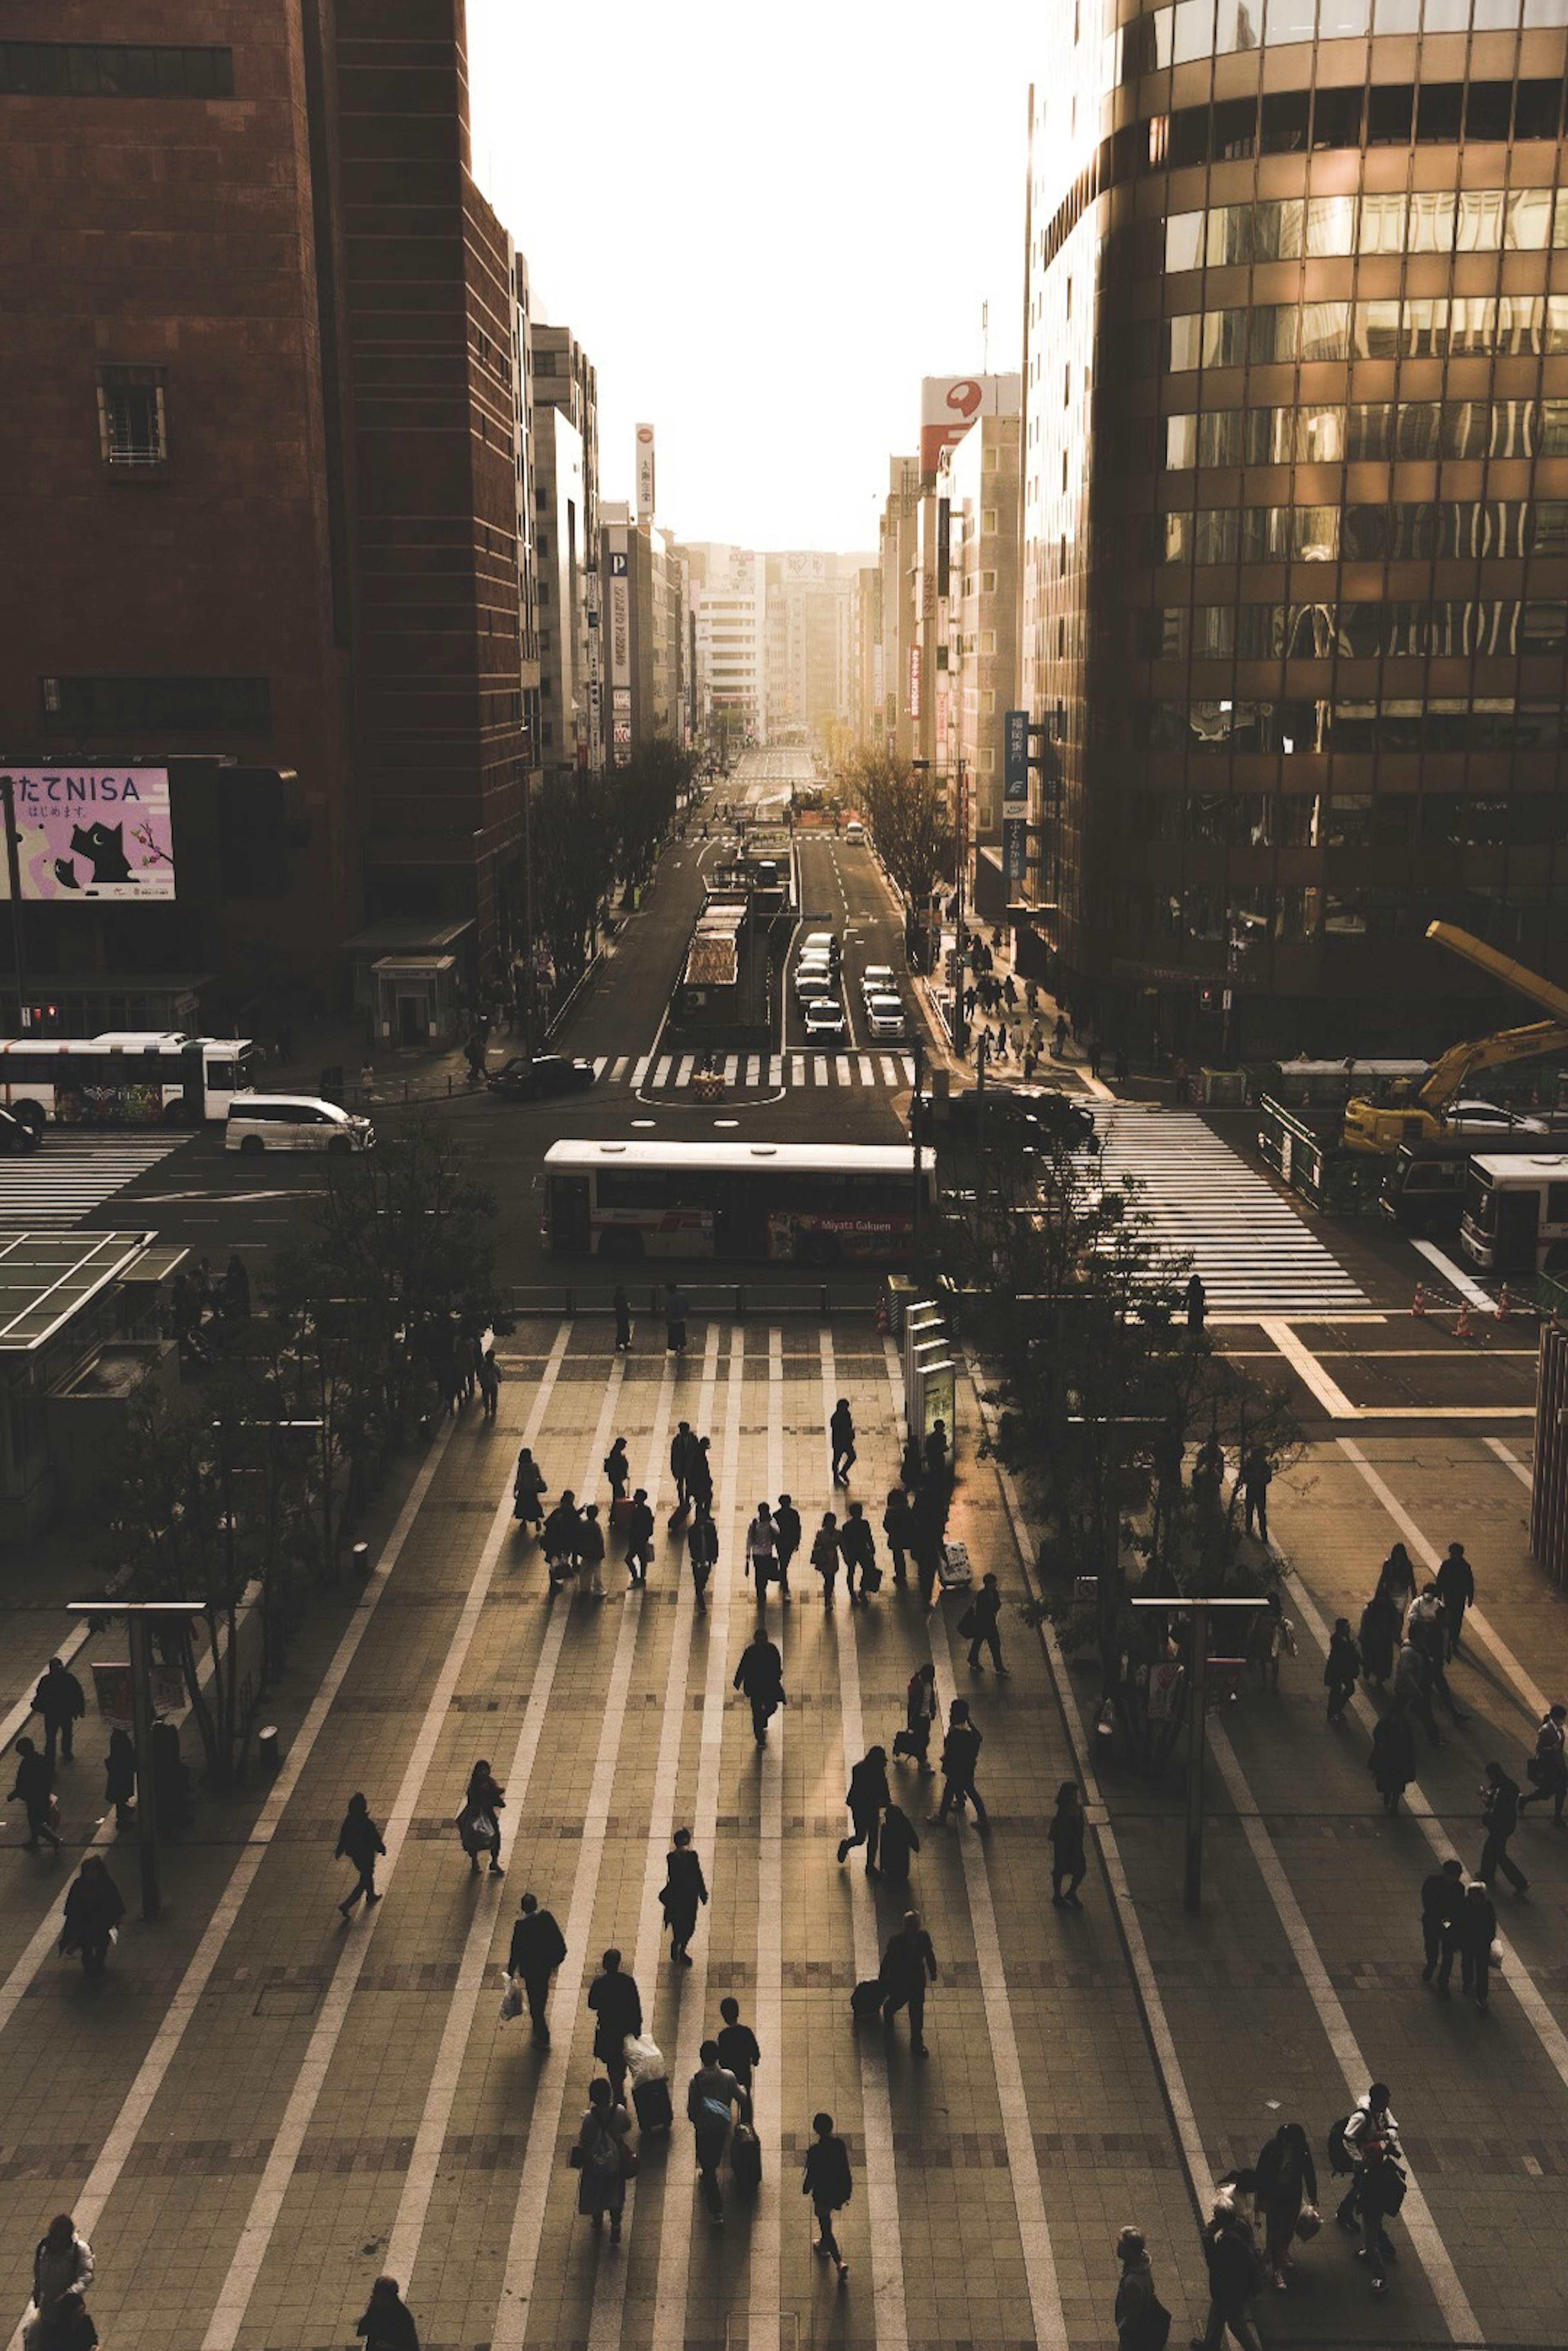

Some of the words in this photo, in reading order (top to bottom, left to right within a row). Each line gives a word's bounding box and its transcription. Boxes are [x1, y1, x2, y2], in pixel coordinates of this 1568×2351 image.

[613, 555, 625, 574] P
[821, 1220, 853, 1232] Miyata
[856, 1220, 891, 1231] Gakuen
